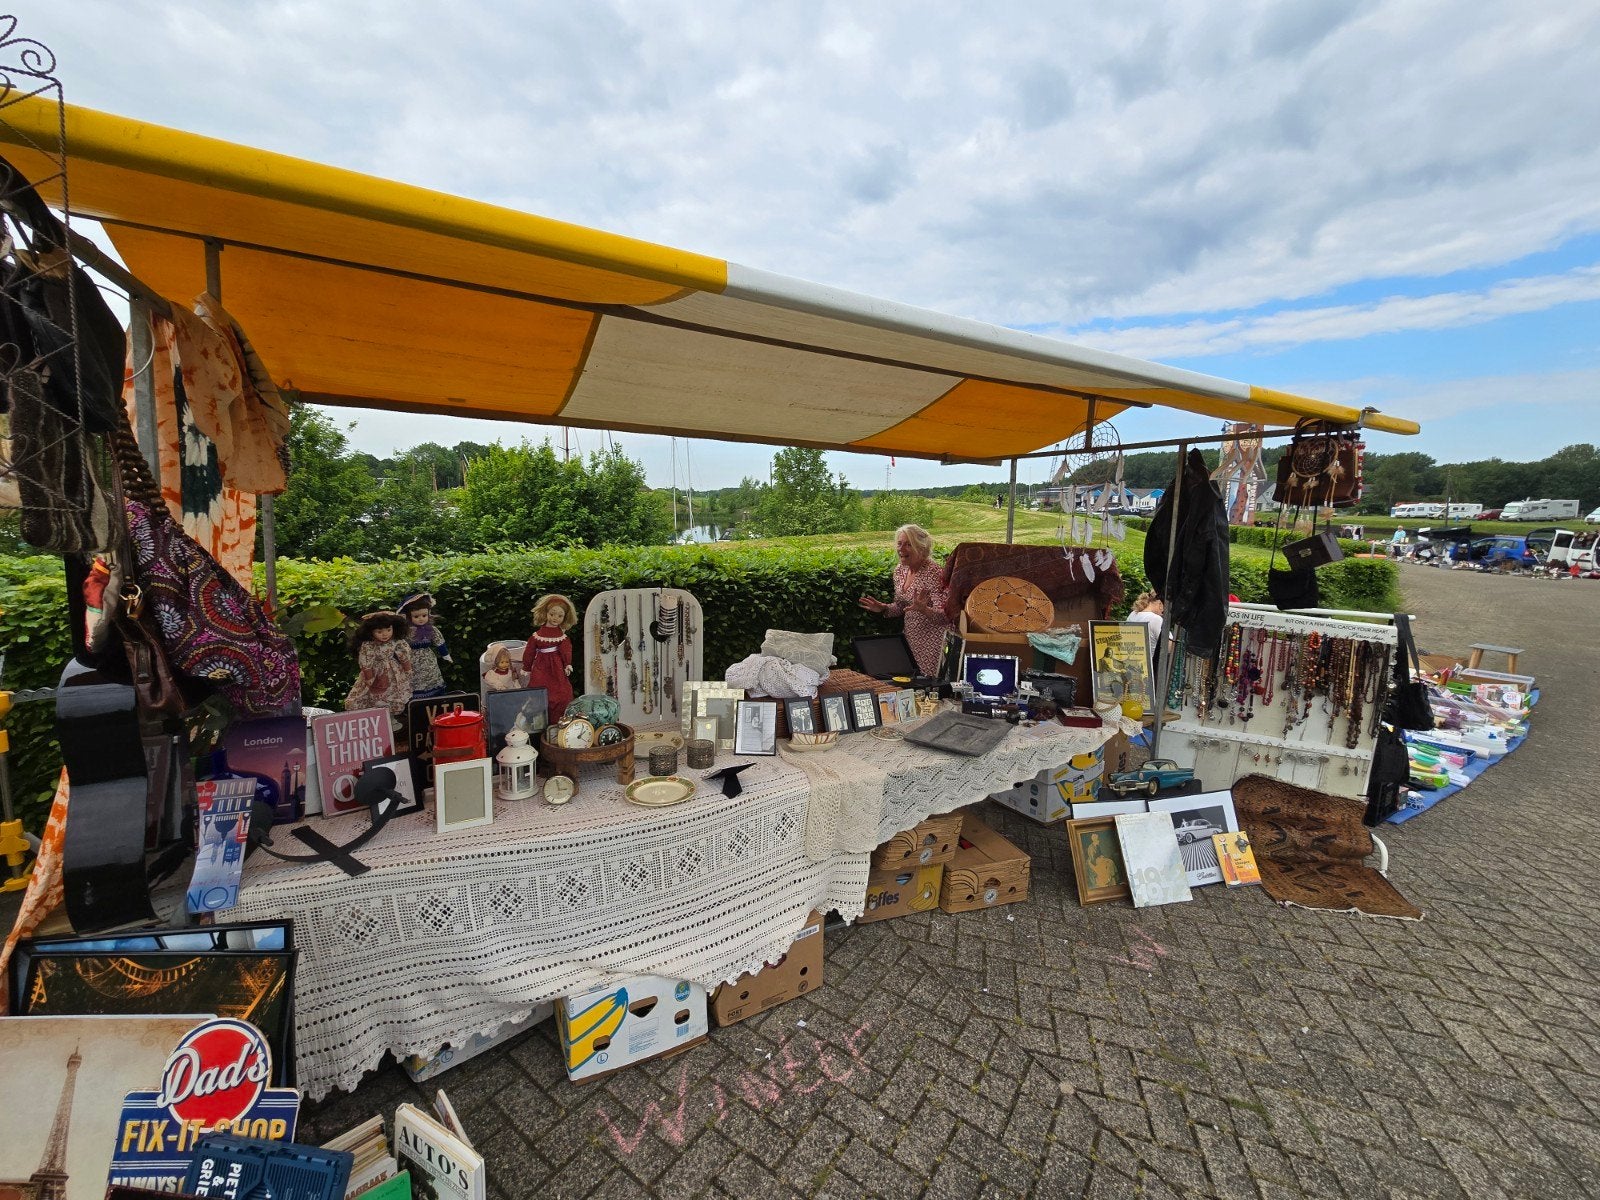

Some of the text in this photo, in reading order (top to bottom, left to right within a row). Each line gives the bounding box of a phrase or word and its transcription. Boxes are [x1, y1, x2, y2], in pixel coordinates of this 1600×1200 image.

[243, 736, 283, 747] London
[325, 715, 381, 745] EVERY
[327, 737, 384, 767] THING
[156, 1038, 270, 1109] Dad's
[121, 1118, 207, 1153] FIX-IT
[398, 1126, 469, 1190] AUTO'S
[195, 1158, 214, 1197] GRIE
[224, 1163, 243, 1199] PIET
